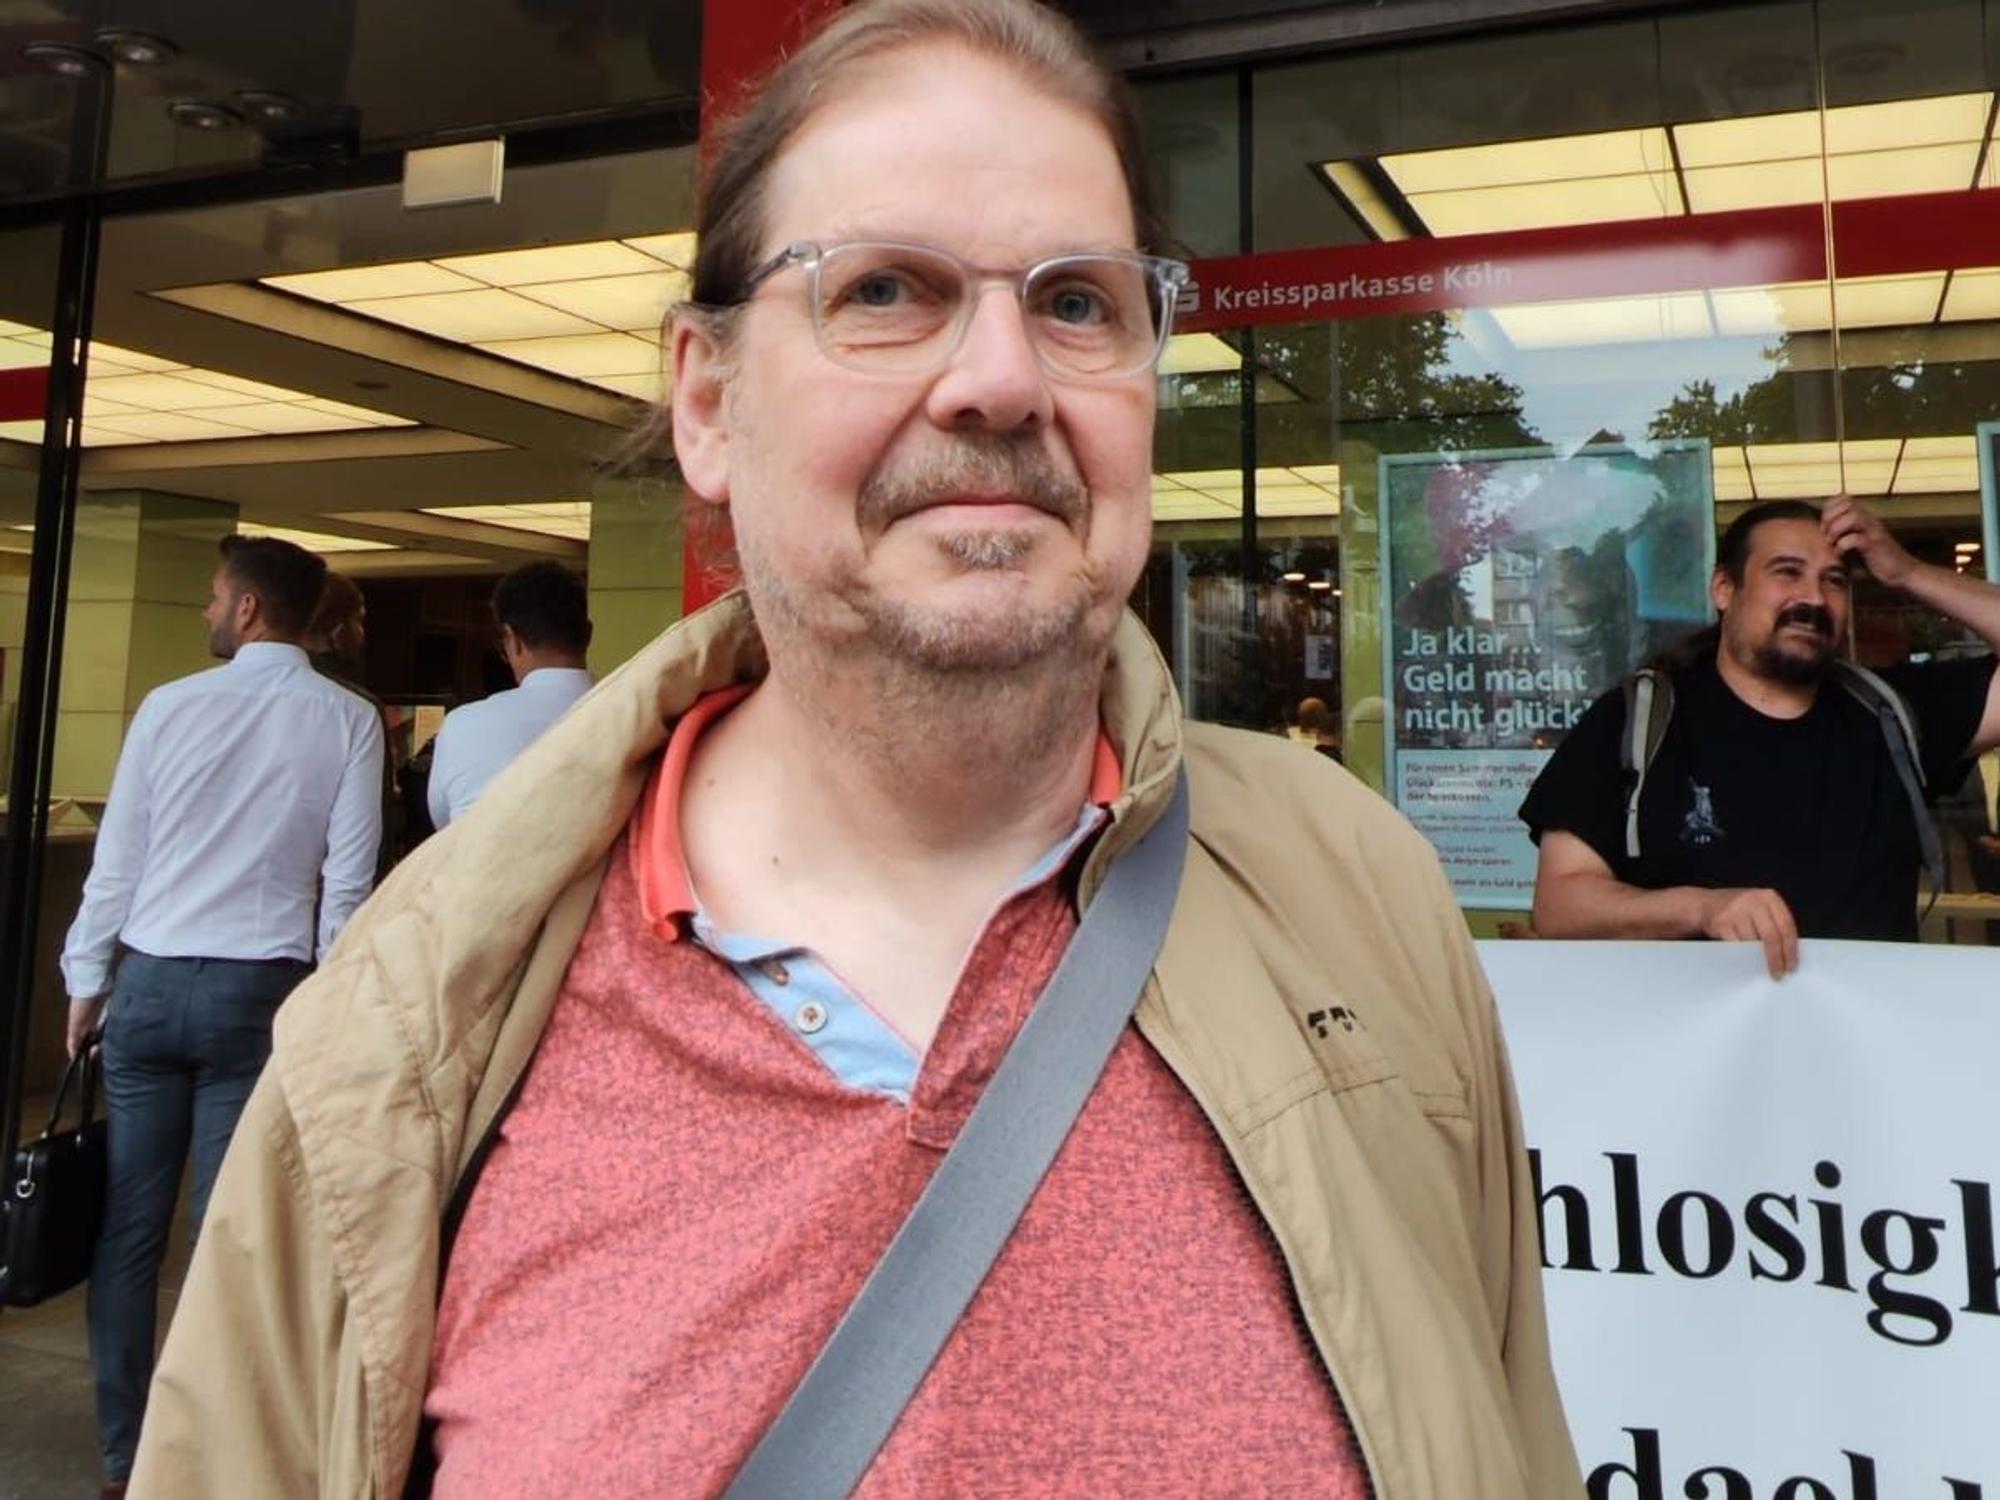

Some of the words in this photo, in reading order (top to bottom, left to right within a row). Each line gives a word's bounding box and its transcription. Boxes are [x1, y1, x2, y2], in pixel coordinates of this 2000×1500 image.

[1213, 271, 1434, 312] Kreissparkasse
[1443, 259, 1513, 292] Köln
[1402, 628, 1437, 655] Ja
[1403, 662, 1474, 693] Geld
[1485, 662, 1587, 692] macht
[1405, 700, 1484, 730] nicht
[1495, 698, 1592, 736] glück
